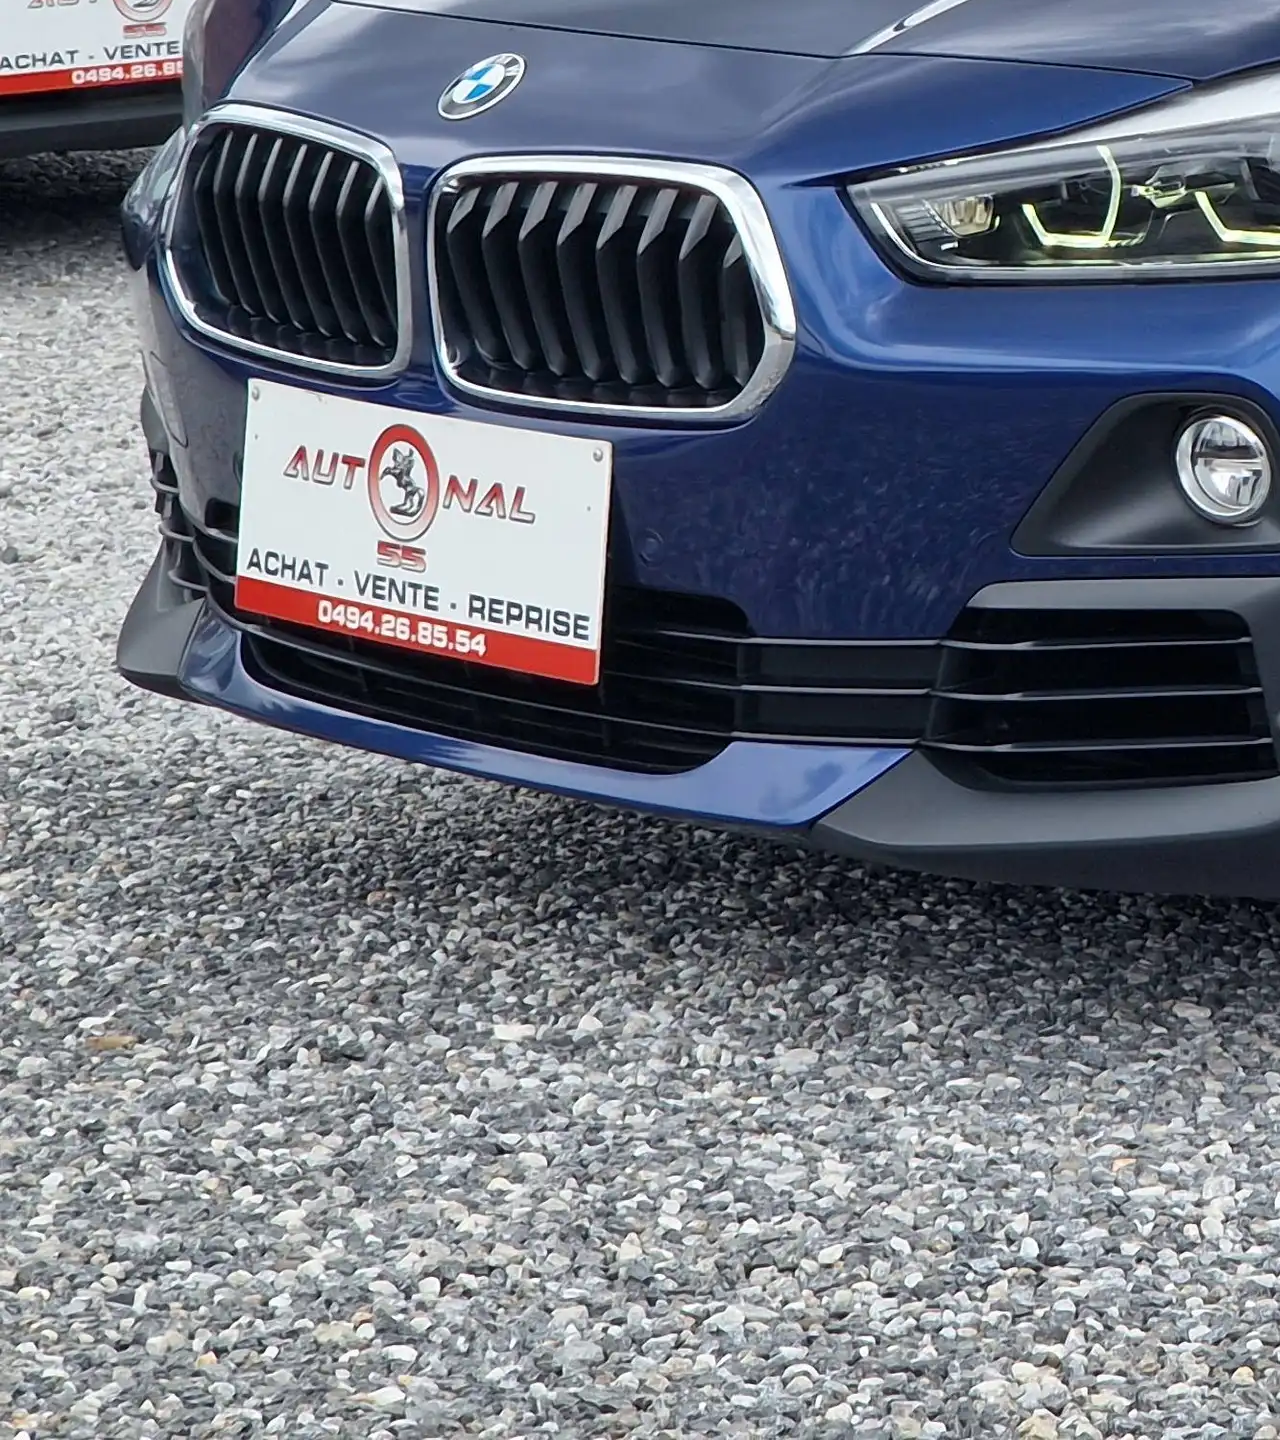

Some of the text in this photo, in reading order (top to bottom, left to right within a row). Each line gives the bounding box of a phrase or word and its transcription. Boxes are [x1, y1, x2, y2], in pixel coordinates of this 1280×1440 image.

[0, 40, 181, 71] ACHAT VENTE
[283, 423, 536, 542] AUTONAL
[376, 539, 427, 574] 55
[246, 547, 591, 642] ACHAT VENTE REPRISE
[317, 599, 488, 657] 0494.26.85.54
